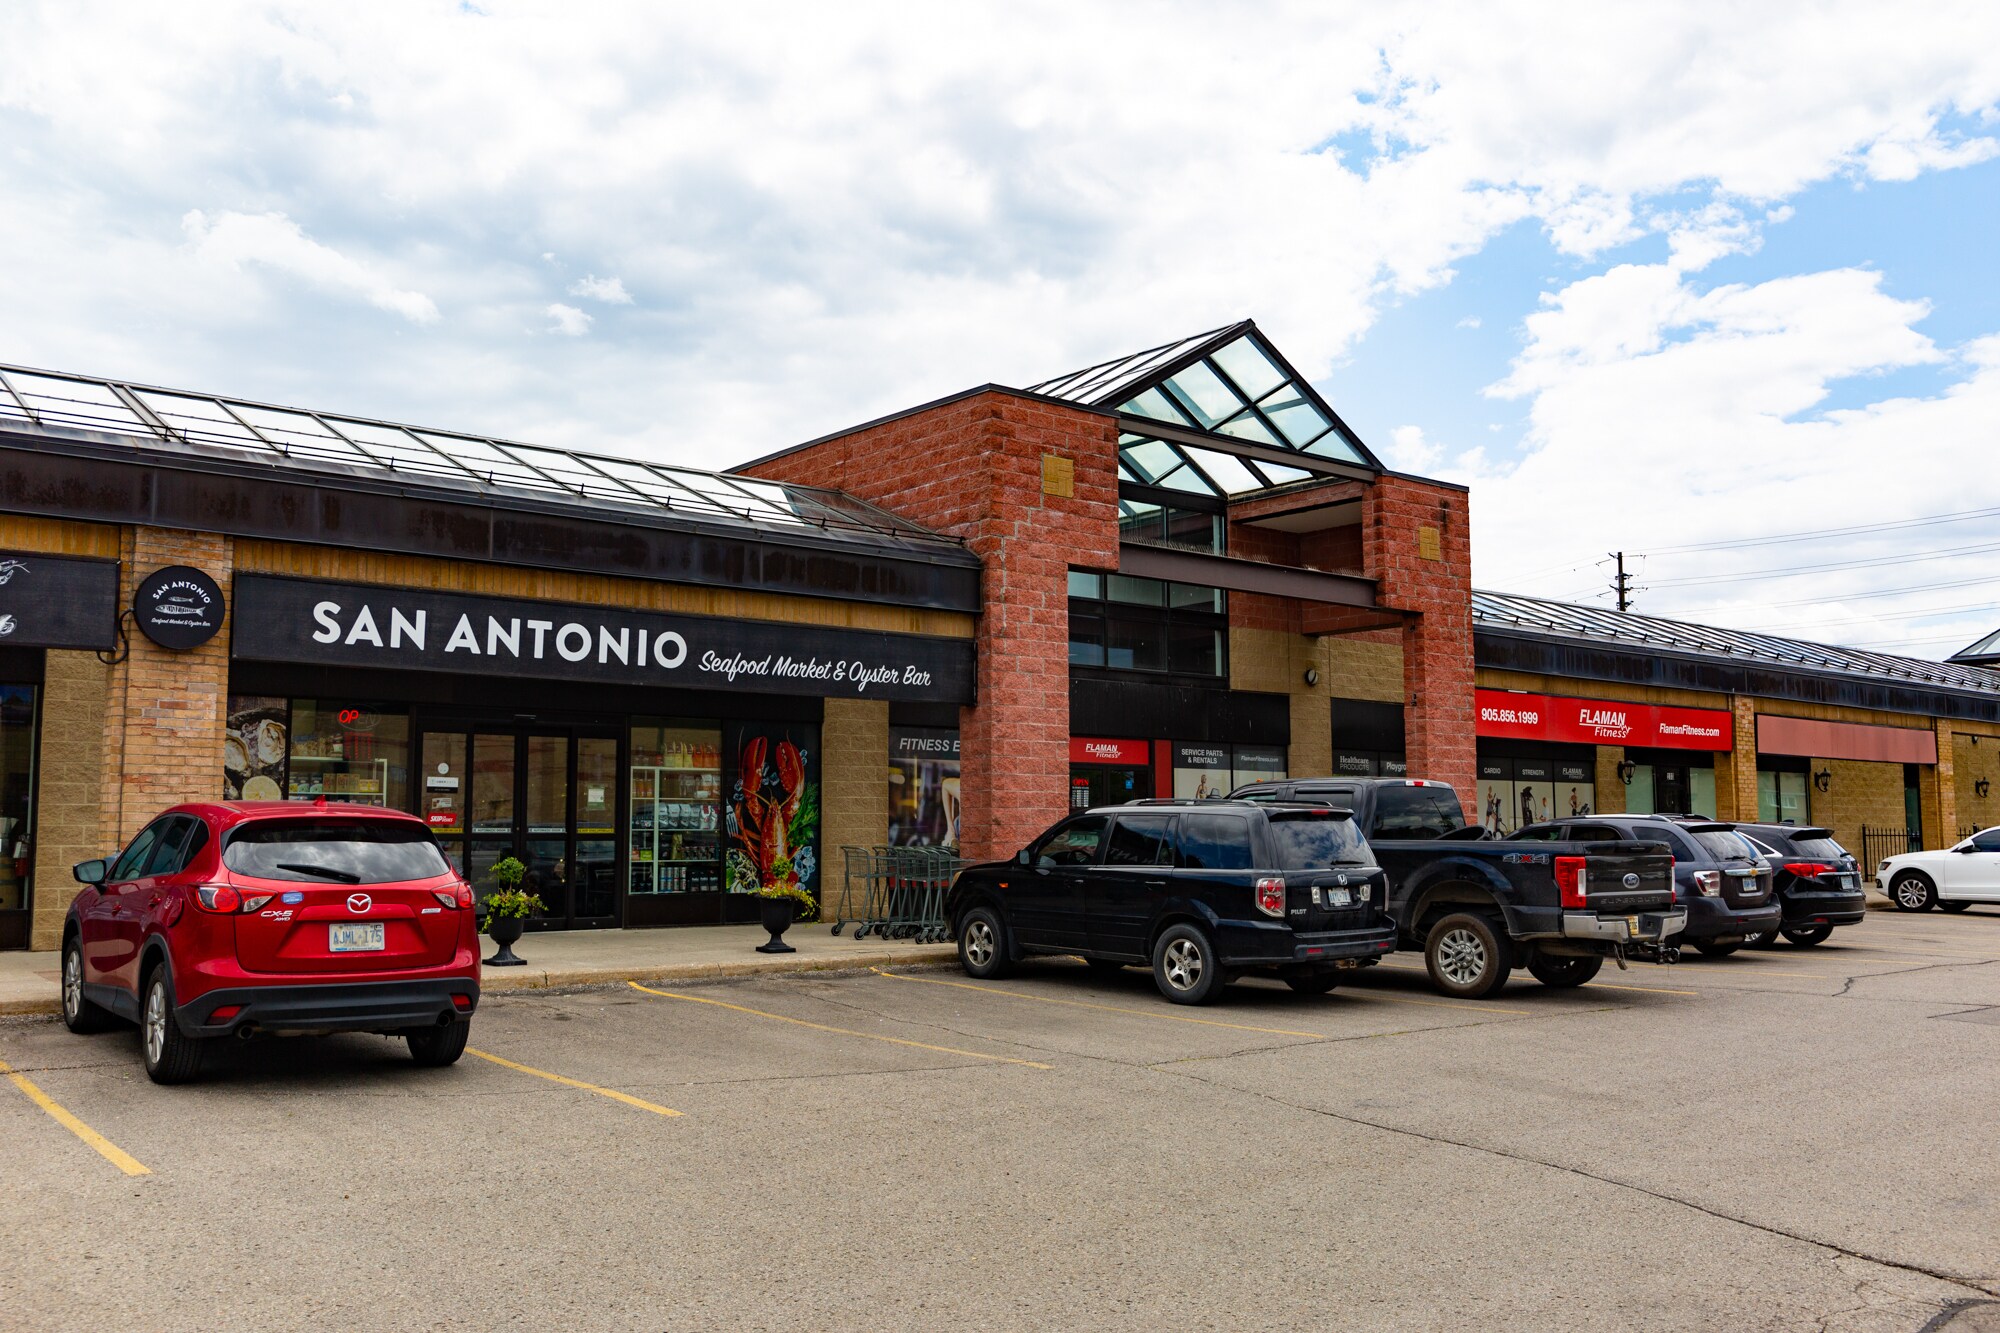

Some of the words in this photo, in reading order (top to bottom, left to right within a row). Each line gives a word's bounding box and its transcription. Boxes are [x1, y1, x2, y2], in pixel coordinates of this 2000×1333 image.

[152, 583, 170, 600] SAN
[171, 580, 211, 603] ANTONIO
[312, 601, 427, 651] SAN
[444, 613, 688, 669] ANTONIO
[698, 650, 771, 682] Seafood
[771, 655, 831, 680] Market
[832, 660, 846, 681] &
[848, 661, 899, 692] Oyster
[902, 665, 931, 686] Bar
[1481, 708, 1538, 725] 905.856.1999
[1579, 708, 1626, 726] FLAMAN
[1594, 726, 1627, 738] Fitness
[1659, 722, 1720, 737] FlamanFitness.com
[899, 737, 950, 752] FITNESS
[1085, 743, 1118, 752] FLAMAN
[1181, 748, 1205, 756] SERVICE
[1205, 749, 1224, 757] PARTS
[1192, 756, 1217, 764] RENTALS
[1339, 755, 1370, 764] Healthcare
[1339, 763, 1370, 771] PRODUCTS
[1483, 767, 1501, 775] CARDIO
[1521, 768, 1545, 776] STRENGTH
[260, 910, 293, 918] CX-5
[364, 930, 382, 944] 175
